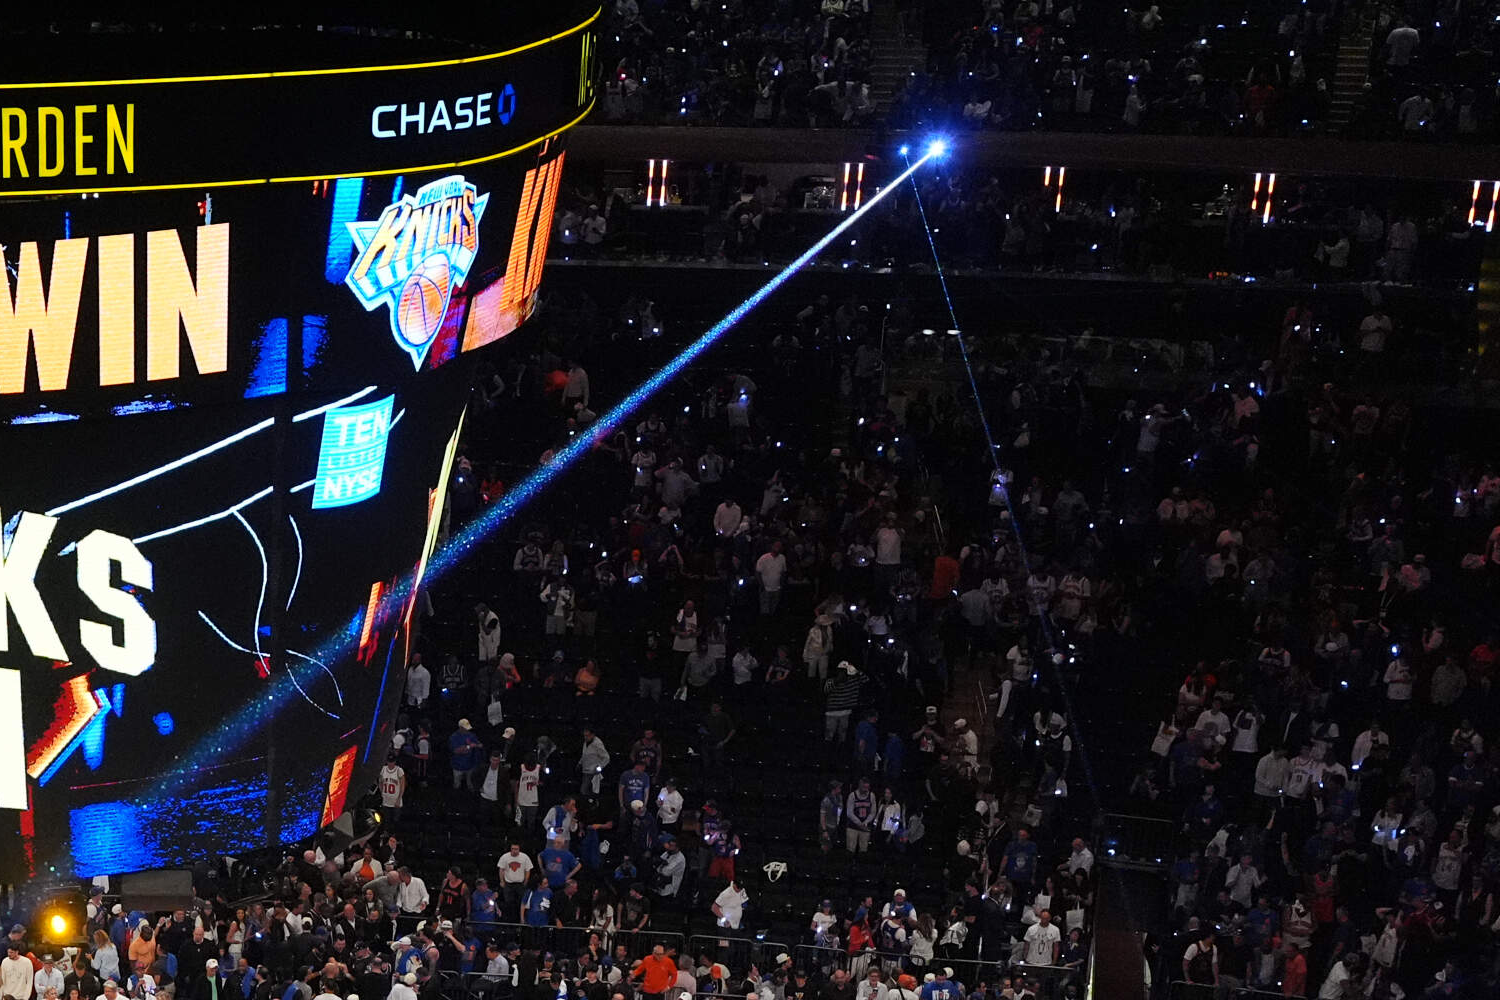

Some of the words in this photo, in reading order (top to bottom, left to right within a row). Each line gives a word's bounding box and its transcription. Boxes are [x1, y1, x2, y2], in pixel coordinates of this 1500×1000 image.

[371, 92, 494, 138] CHASE
[352, 188, 477, 281] KNICKS
[333, 407, 389, 446] TEN
[322, 465, 380, 500] NYSE
